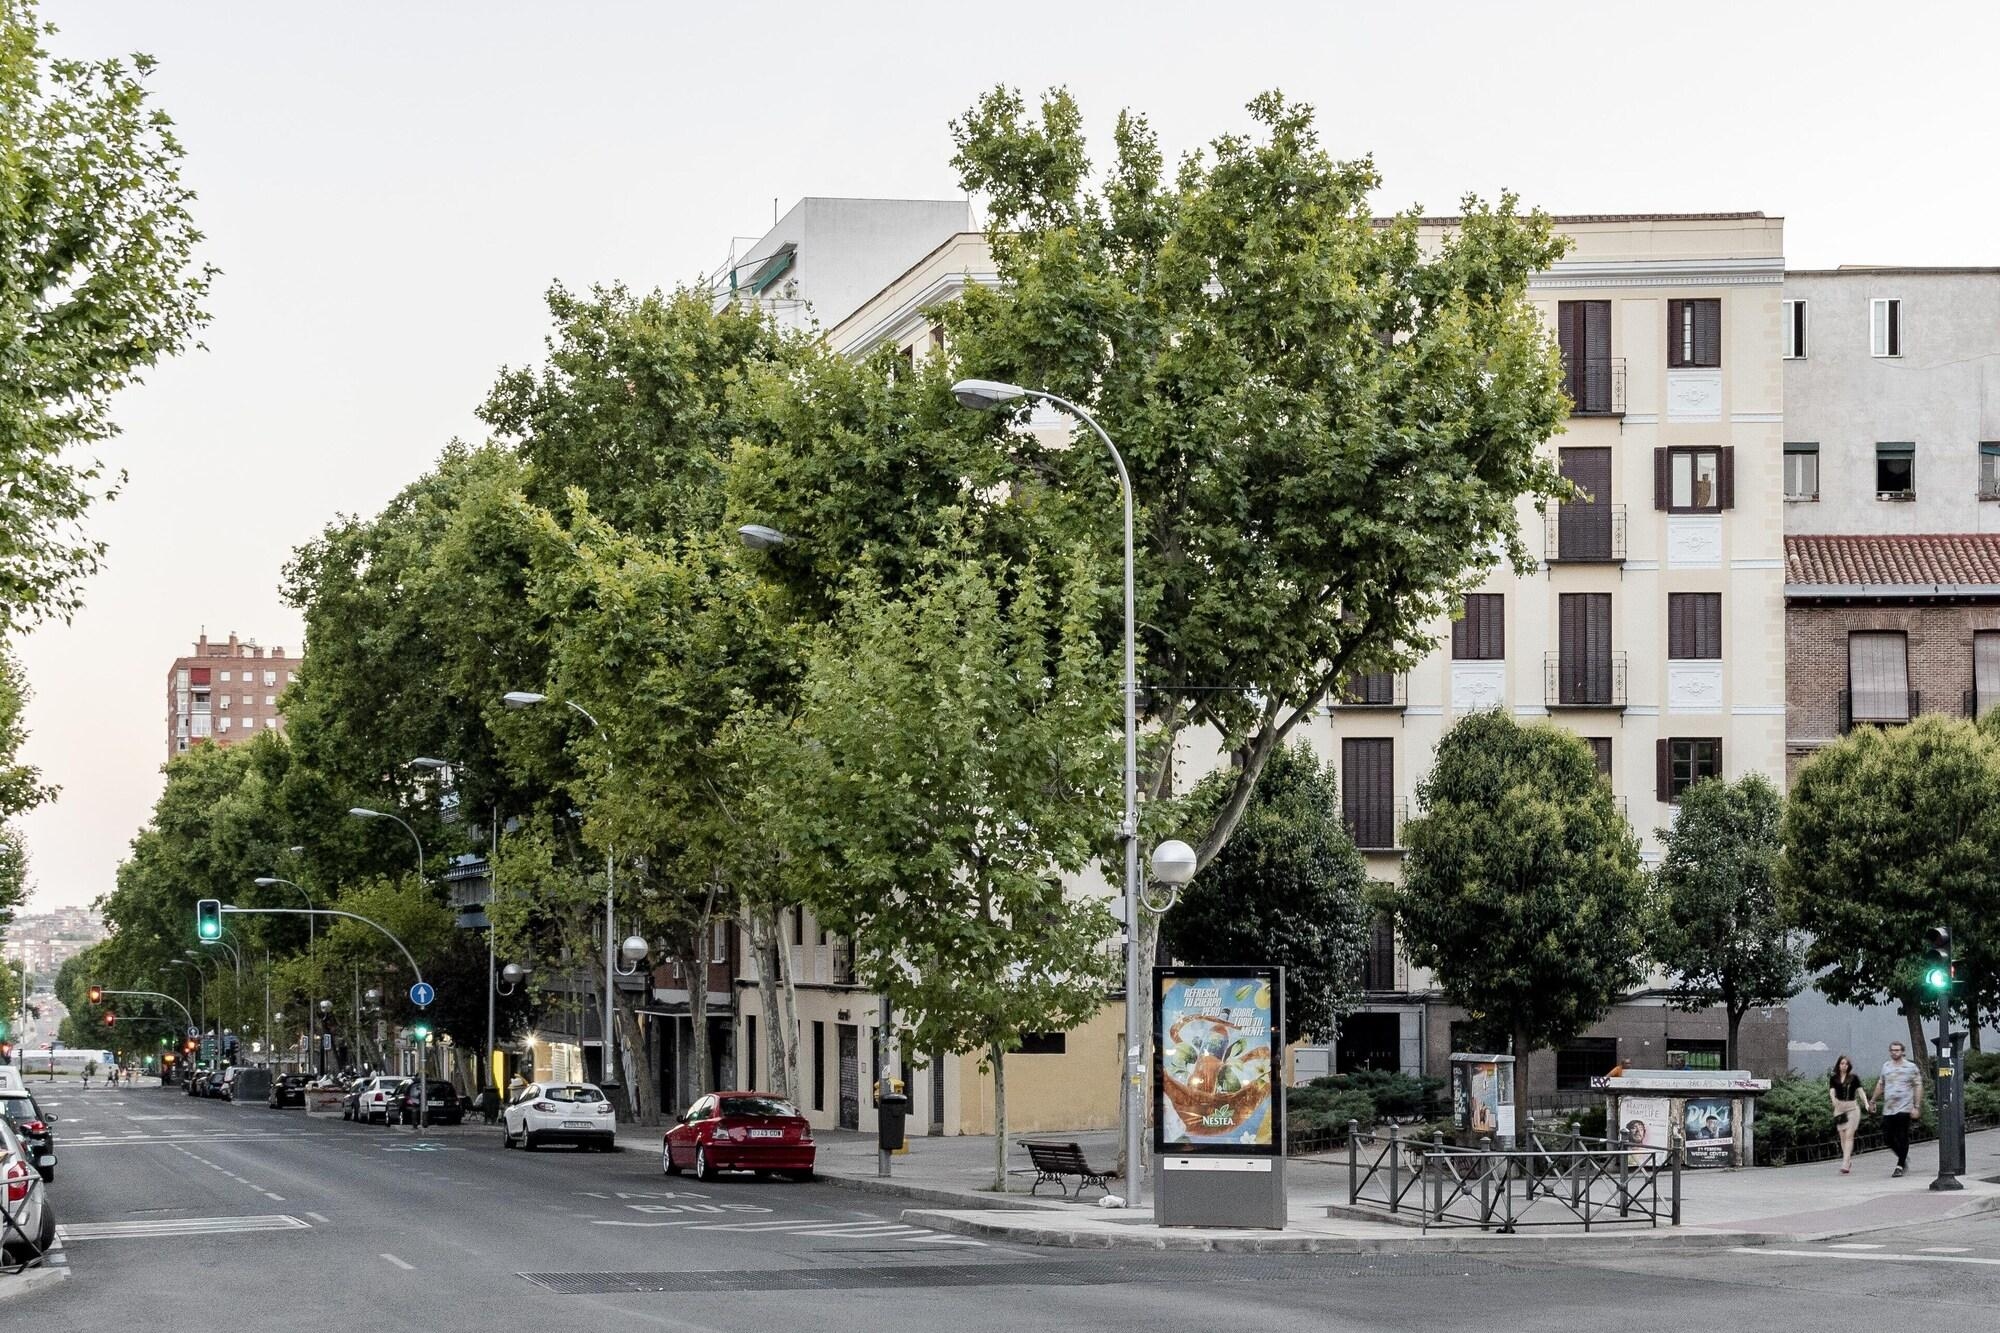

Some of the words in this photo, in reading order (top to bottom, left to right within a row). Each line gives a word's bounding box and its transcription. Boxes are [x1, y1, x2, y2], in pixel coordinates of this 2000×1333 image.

[1184, 988, 1220, 998] REFRESCA
[1184, 998, 1195, 1007] TU
[1195, 998, 1223, 1008] CUERPO
[1202, 1007, 1221, 1017] PERO
[1232, 1008, 1256, 1017] SOBRE
[1234, 1017, 1253, 1027] TODO
[1253, 1017, 1264, 1027] TU
[1240, 1026, 1266, 1036] MENTE
[1686, 1105, 1731, 1124] DUKI
[1202, 1116, 1234, 1126] NESTEA
[625, 1204, 774, 1213] BUS
